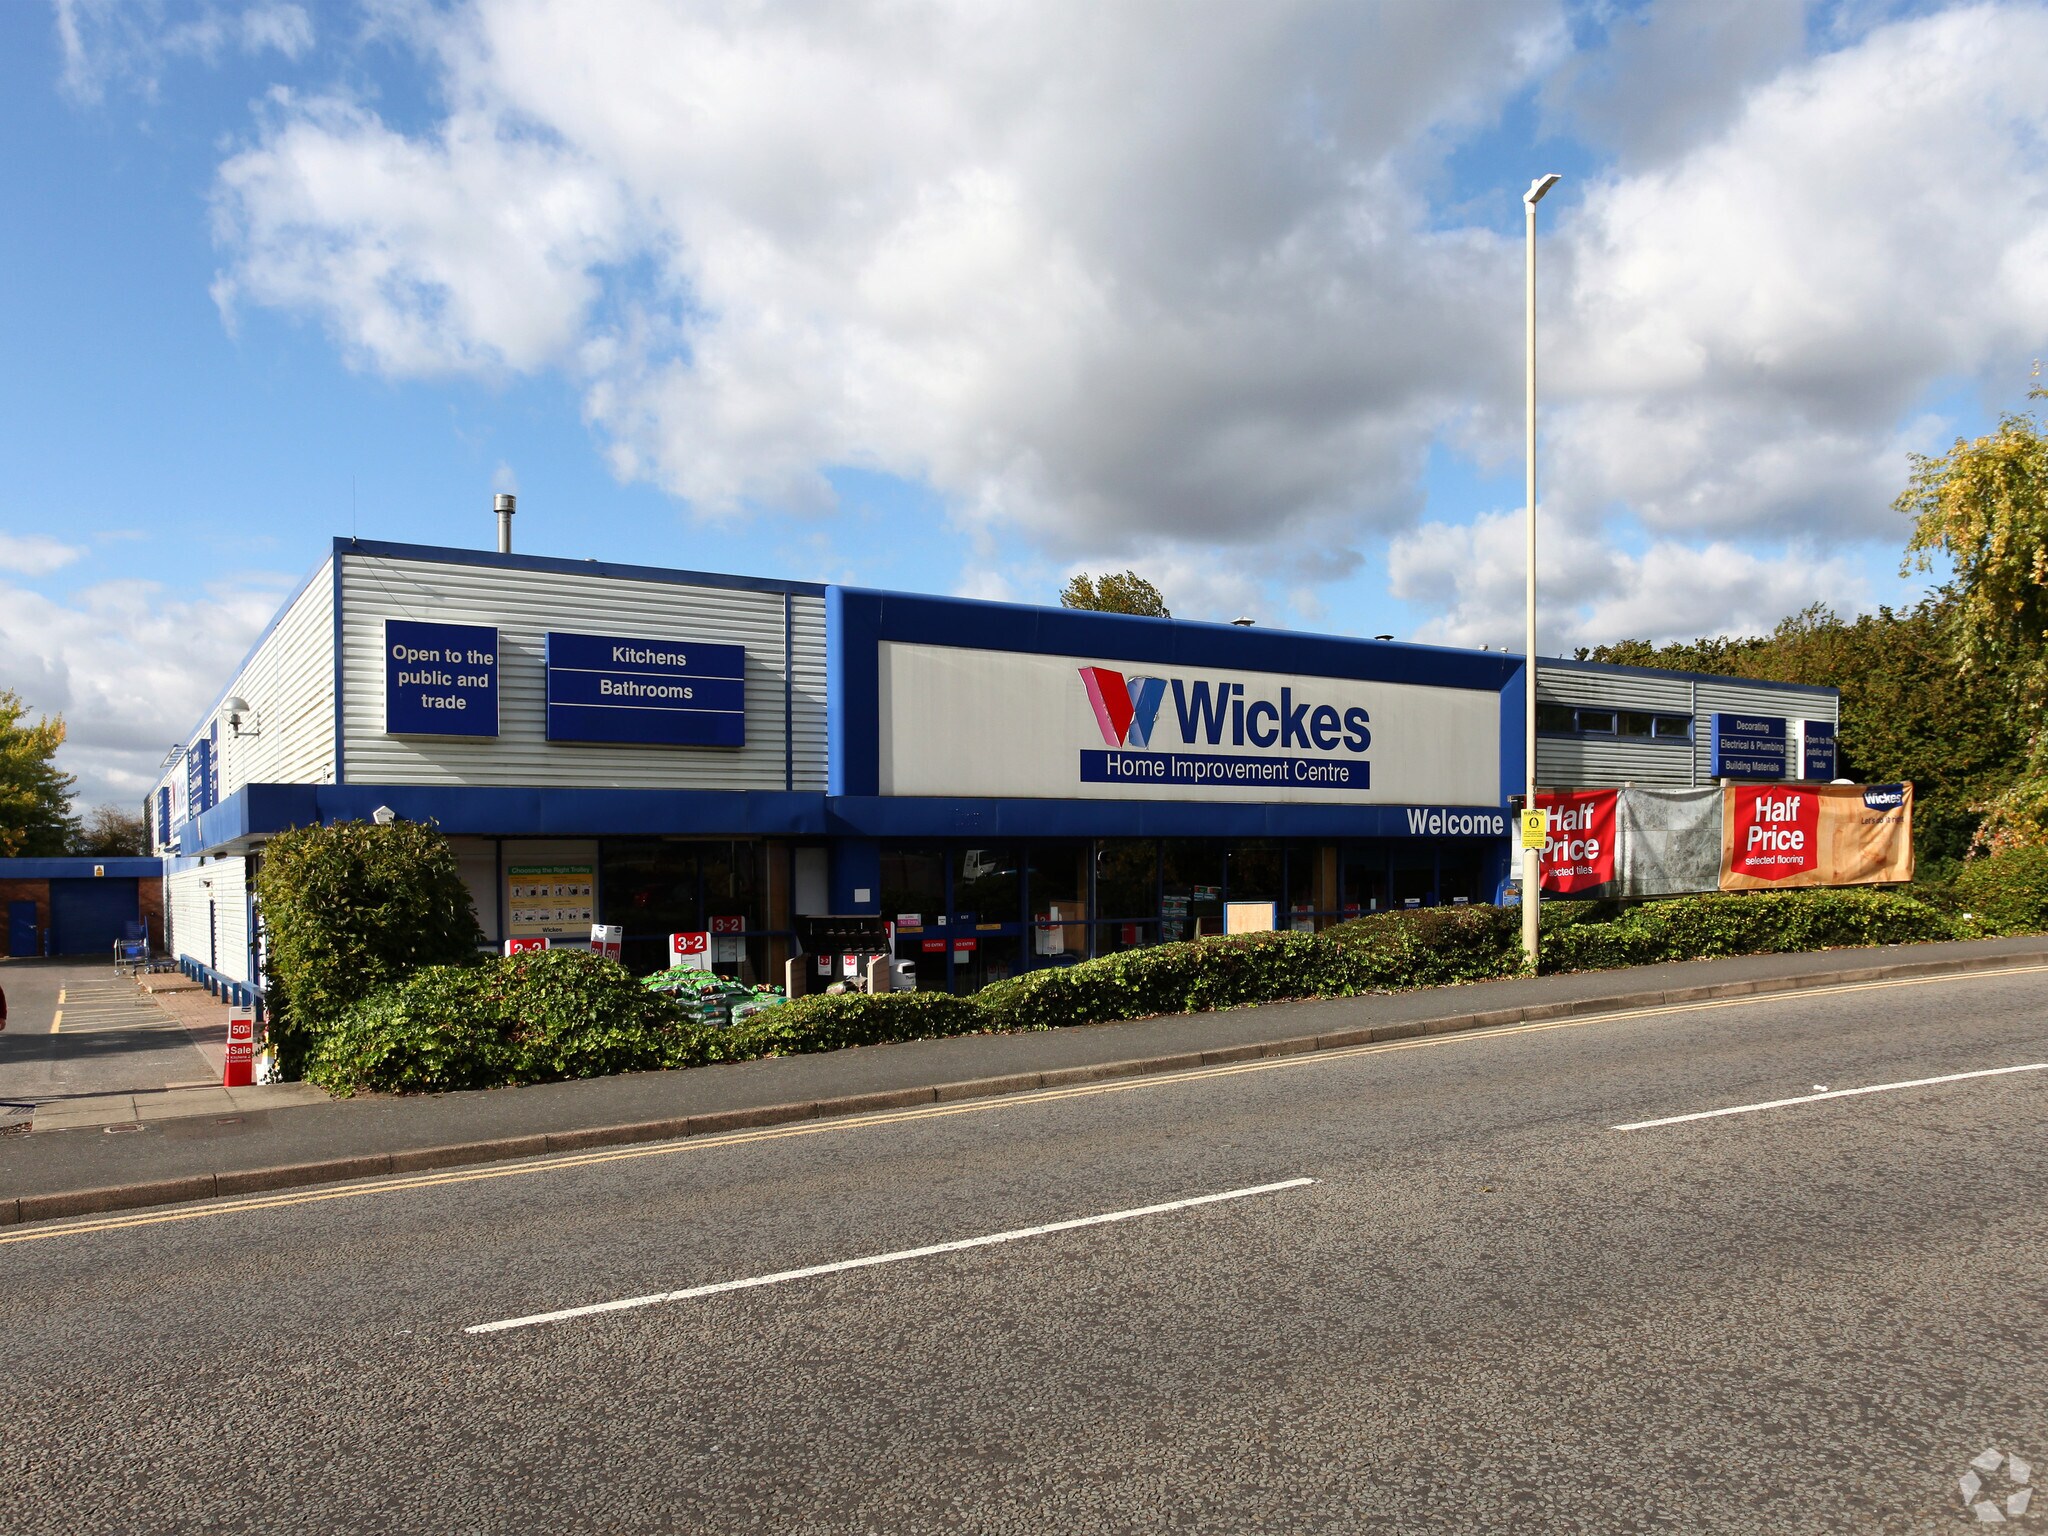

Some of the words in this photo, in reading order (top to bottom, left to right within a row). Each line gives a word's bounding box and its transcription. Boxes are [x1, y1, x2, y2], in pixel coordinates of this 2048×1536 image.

[393, 644, 440, 663] Open
[445, 649, 462, 663] to
[467, 650, 494, 665] the
[612, 646, 687, 666] Kitchens
[398, 670, 452, 687] public
[457, 674, 489, 688] and
[600, 679, 693, 699] Bathrooms
[421, 694, 467, 710] trade
[1170, 678, 1372, 753] Wickes
[1736, 720, 1770, 734] Decorating
[1720, 738, 1750, 751] Electrical
[1750, 741, 1755, 750] &
[1756, 741, 1784, 754] Plumbing
[1805, 735, 1819, 745] Open
[1820, 736, 1826, 744] to
[1825, 736, 1834, 745] the
[1806, 748, 1822, 757] public
[1823, 748, 1833, 757] and
[1107, 753, 1165, 777] Home
[1171, 756, 1289, 783] Improvement
[1294, 760, 1350, 782] Centre
[1725, 760, 1751, 772] Building
[1752, 762, 1780, 772] Materials
[1812, 760, 1827, 769] trade
[1864, 792, 1902, 805] Wickes
[1546, 802, 1595, 832] Half
[1755, 796, 1800, 822] Half
[1406, 808, 1504, 835] Welcome
[1861, 816, 1875, 825] Let's
[1747, 825, 1804, 852] Price
[1539, 834, 1600, 863] Price
[1745, 855, 1776, 865] selected
[1777, 855, 1804, 865] flooring
[553, 866, 570, 874] Right
[1576, 865, 1593, 875] tiles
[716, 919, 724, 932] 3
[731, 918, 739, 931] 2
[677, 937, 687, 951] 3
[694, 935, 704, 949] 2
[230, 1046, 251, 1055] Sale
